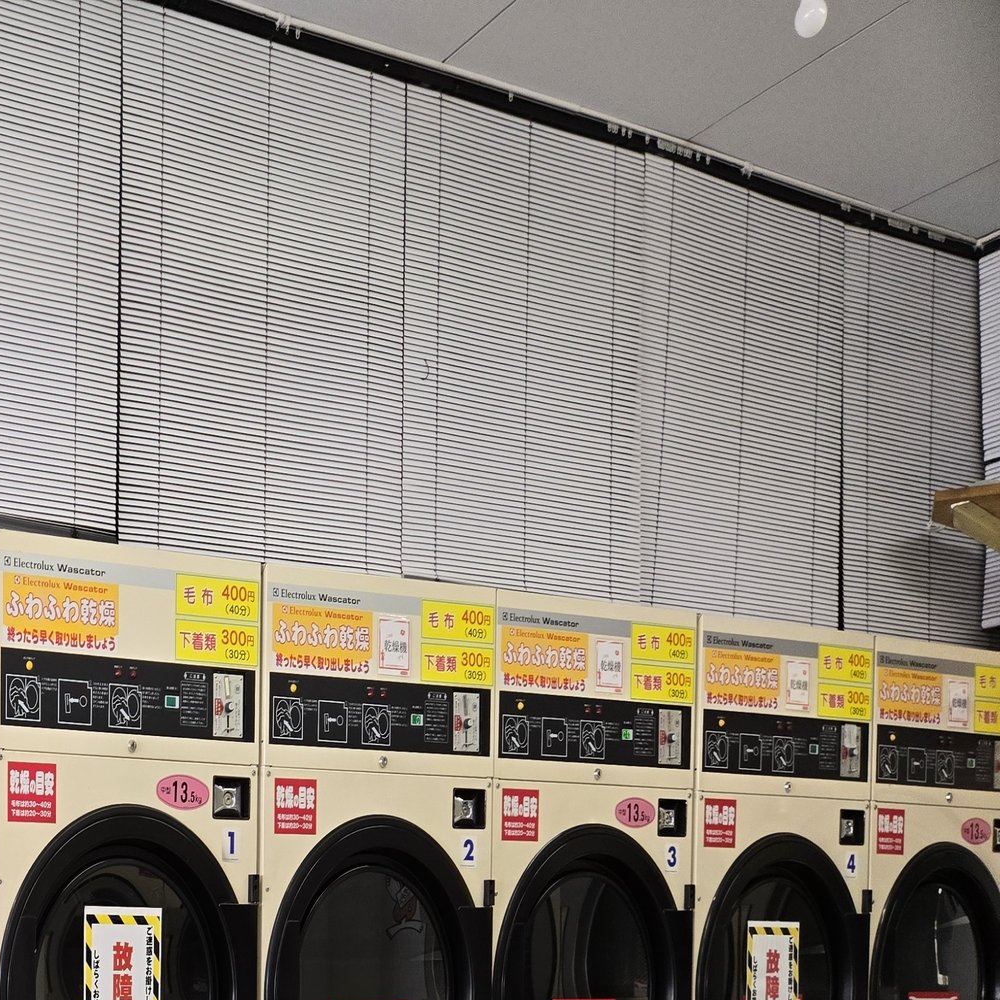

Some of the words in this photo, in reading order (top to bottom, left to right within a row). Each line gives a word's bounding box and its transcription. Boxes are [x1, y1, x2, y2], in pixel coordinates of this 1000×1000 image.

[13, 557, 54, 572] Electrolux
[57, 563, 106, 578] Wascator
[22, 576, 61, 590] Electrolux
[63, 582, 108, 595] Wascator
[184, 587, 214, 606] 毛布
[221, 584, 255, 603] 400円
[281, 588, 317, 601] Electrolux
[318, 594, 361, 605] Wascator
[5, 591, 116, 628] ふわふわ乾燥
[225, 604, 251, 618] (40分)
[289, 606, 322, 617] Electrolux
[324, 610, 363, 621] Wascator
[428, 612, 455, 629] 毛布
[461, 610, 491, 626] 400円
[509, 613, 540, 624] Electrolux
[542, 617, 579, 628] Wascator
[7, 626, 116, 651] 終ったら早く取り出しましょう
[179, 631, 217, 651] 下着類
[221, 629, 255, 647] 300円
[275, 620, 370, 651] ふわふわ乾燥
[464, 629, 487, 639] (40分)
[516, 628, 545, 640] Electrolux
[546, 632, 581, 643] Wascator
[638, 634, 660, 650] 毛布
[666, 633, 692, 648] 400円
[713, 636, 740, 646] Electrolux
[741, 639, 773, 650] Wascator
[224, 648, 250, 662] (30分)
[384, 640, 407, 654] 乾燥機
[503, 641, 586, 671] ふわふわ乾燥
[669, 649, 688, 659] (40分)
[275, 653, 370, 674] 終ったら早く取り出しましょう
[424, 654, 457, 672] 下着類
[461, 652, 491, 668] 300円
[848, 653, 870, 668] 400円
[464, 670, 487, 681] (30分)
[503, 672, 586, 692] 終ったら早く取り出しましょう
[634, 674, 662, 691] 下着類
[665, 672, 691, 687] 300円
[706, 663, 779, 689] ふわふわ乾燥
[668, 689, 688, 699] (30分)
[820, 693, 845, 709] 下着類
[847, 690, 869, 706] 300円
[880, 682, 941, 705] ふわふわ乾燥
[9, 769, 54, 796] 乾燥の目安
[172, 781, 202, 804] 13.5kg
[276, 785, 315, 809] 乾燥の目安
[228, 831, 235, 855] 1
[463, 838, 474, 861] 2
[667, 846, 677, 867] 3
[846, 854, 856, 873] 4
